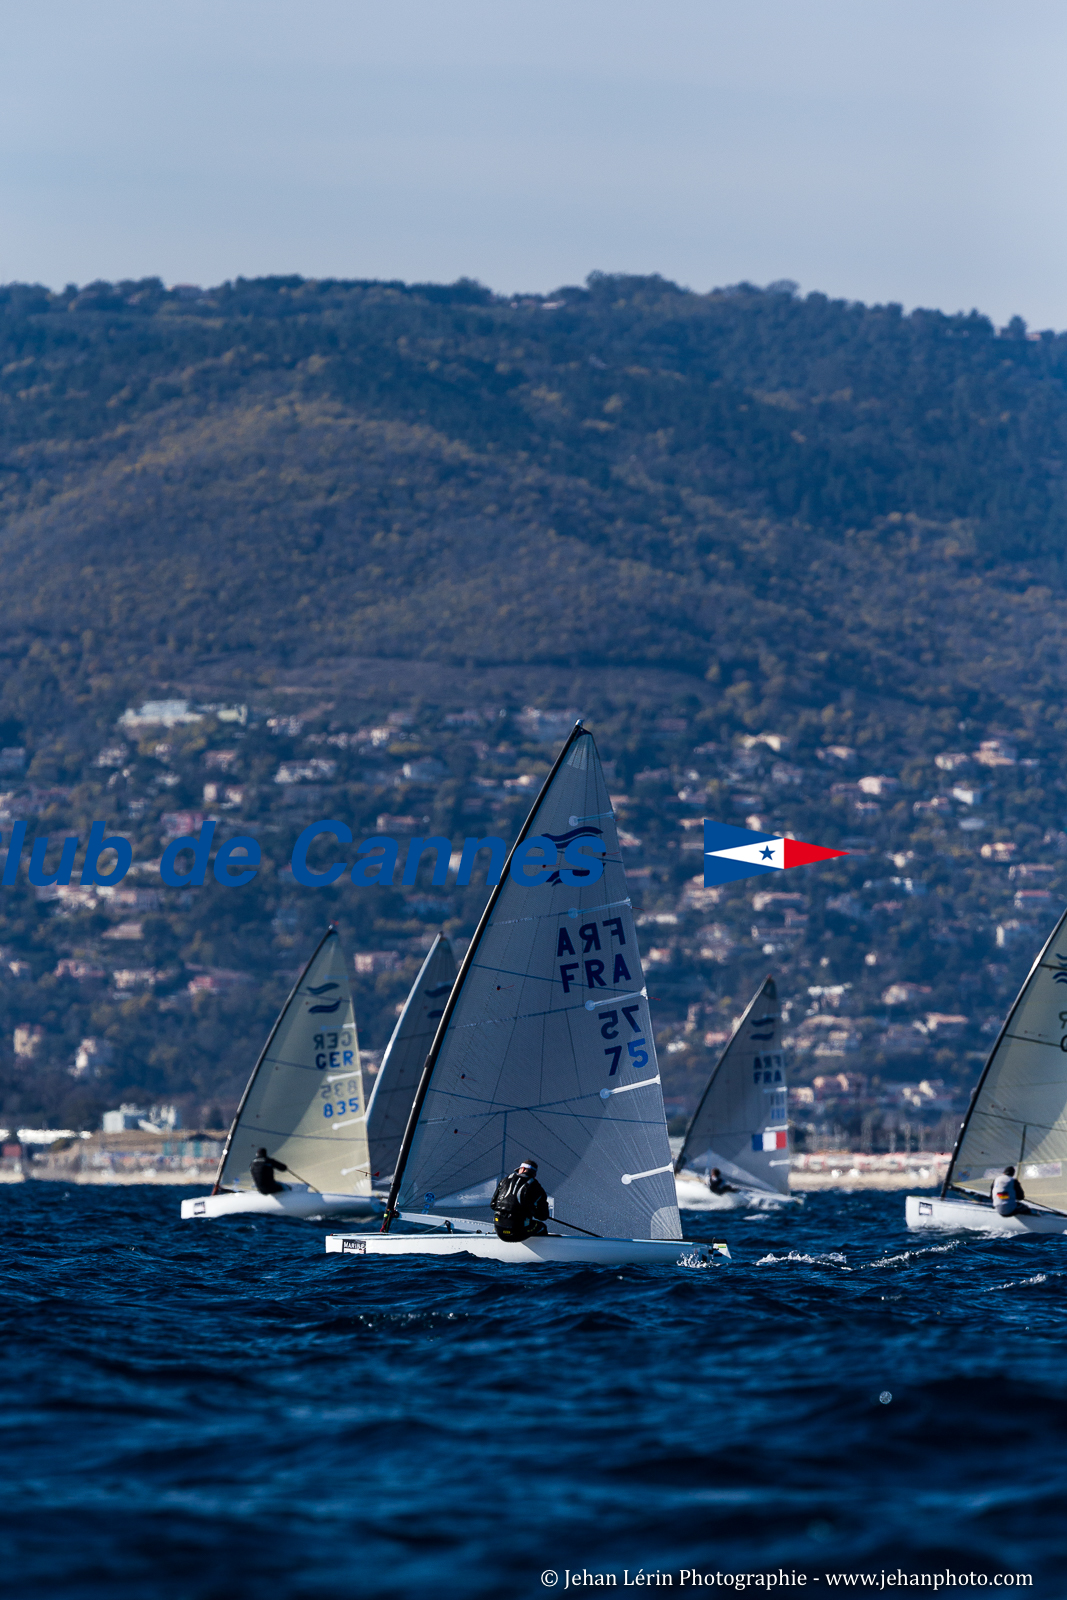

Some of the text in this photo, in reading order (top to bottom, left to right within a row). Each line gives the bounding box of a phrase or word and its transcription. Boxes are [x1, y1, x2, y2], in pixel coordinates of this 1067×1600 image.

[559, 953, 632, 993] FRA
[315, 1050, 354, 1070] GER
[604, 1038, 649, 1076] 75
[753, 1069, 782, 1084] FRA
[323, 1097, 360, 1118] 835
